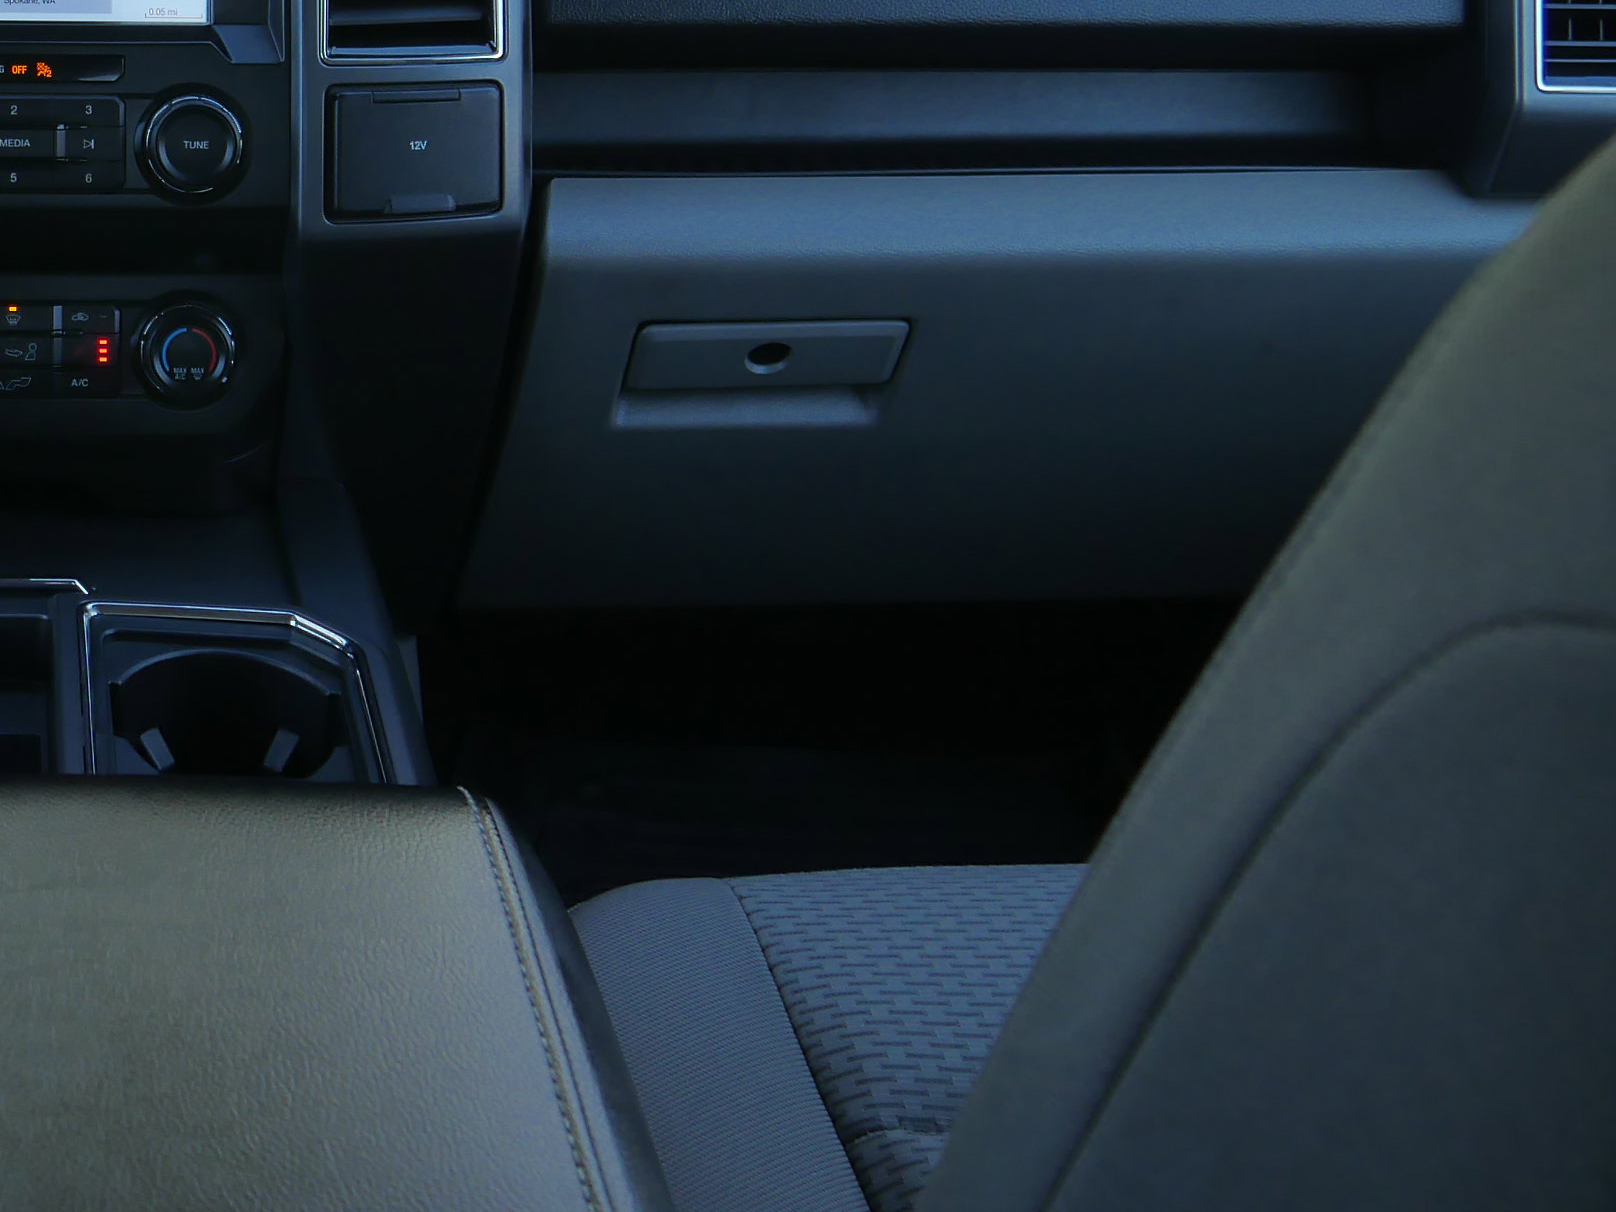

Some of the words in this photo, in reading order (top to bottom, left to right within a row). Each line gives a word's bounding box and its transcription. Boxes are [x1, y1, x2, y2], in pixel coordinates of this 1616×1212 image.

[149, 8, 165, 16] 0.05
[11, 65, 28, 75] OFF
[10, 105, 18, 115] 2
[85, 105, 92, 115] 3
[0, 139, 31, 148] MEDIA
[184, 140, 210, 150] TUNE
[410, 140, 428, 150] 12V
[10, 173, 18, 183] 5
[85, 173, 92, 183] 6
[71, 378, 89, 387] A/C
